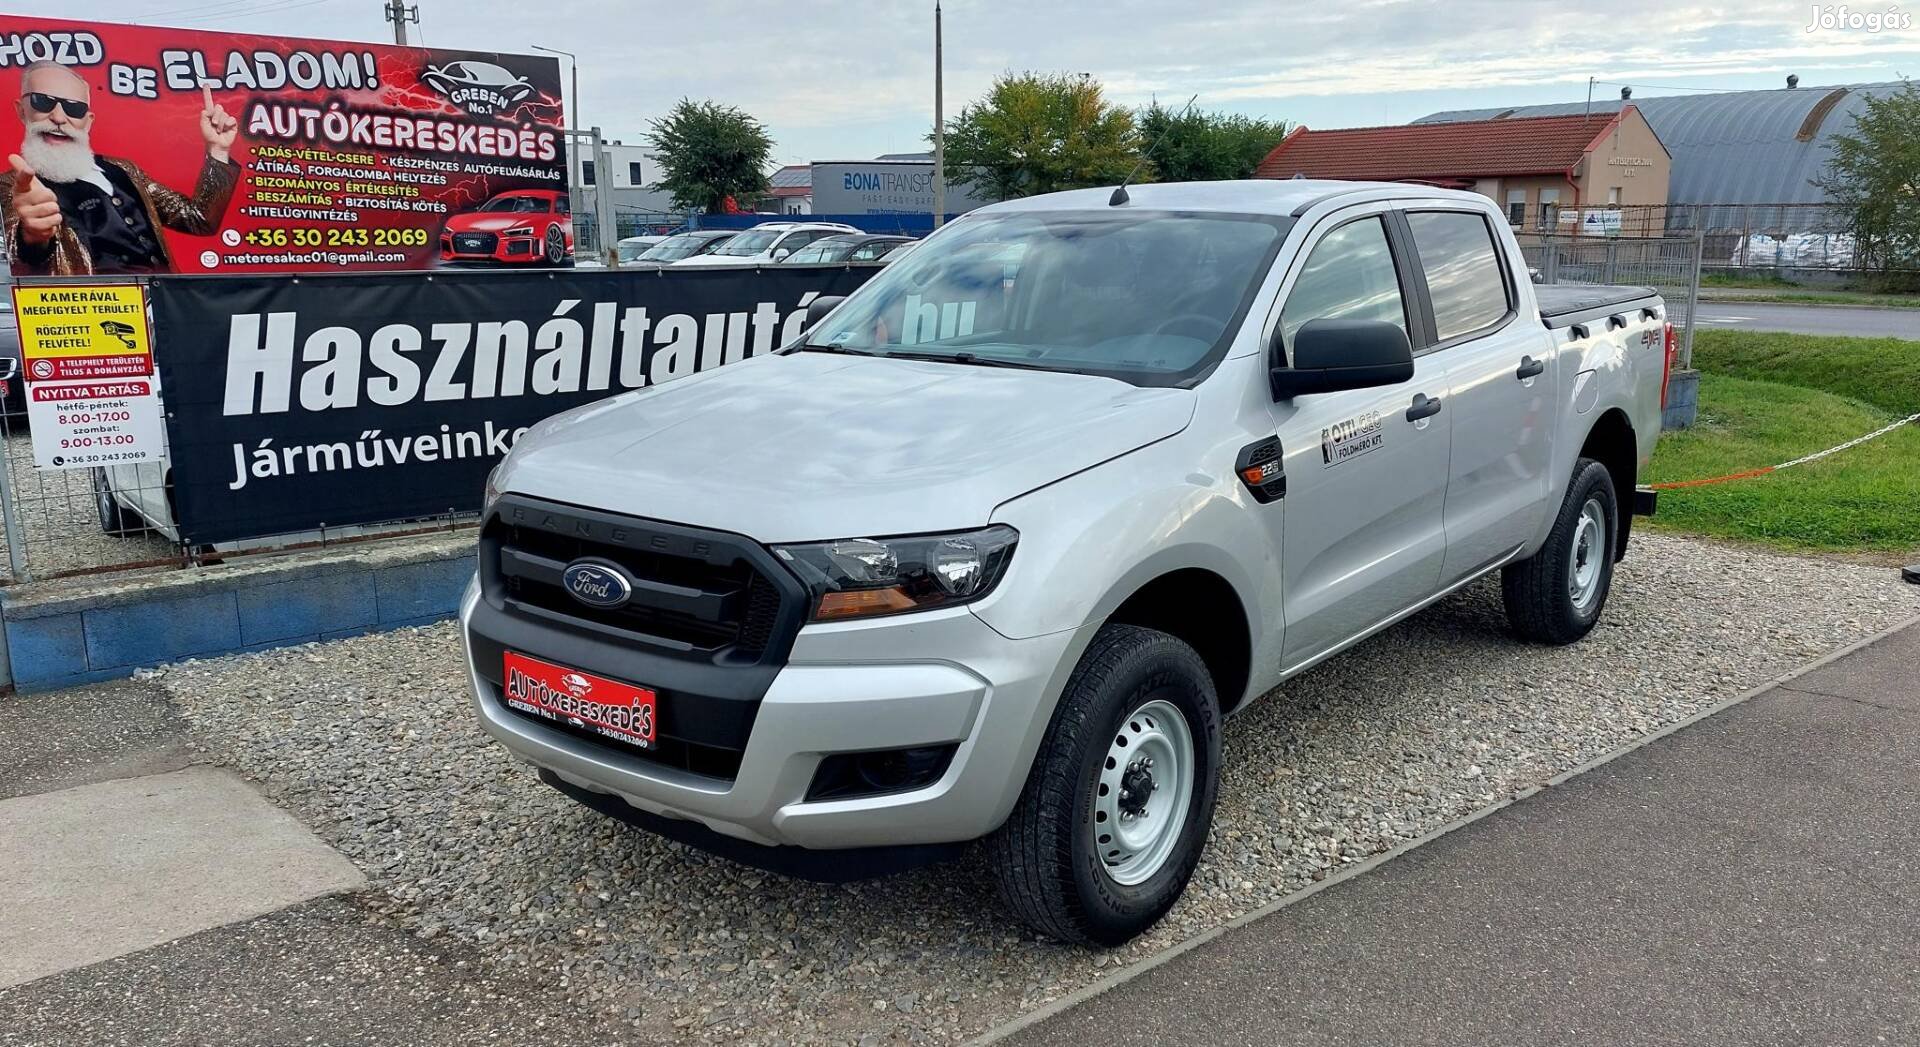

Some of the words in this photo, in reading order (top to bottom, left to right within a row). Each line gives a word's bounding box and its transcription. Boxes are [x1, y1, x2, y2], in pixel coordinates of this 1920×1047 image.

[0, 33, 103, 66] HOZD
[111, 64, 157, 98] BE
[162, 51, 378, 89] ELADOM!
[451, 88, 509, 109] GREBEN
[468, 102, 493, 115] No.1
[250, 103, 556, 161] AUTÓKERESKEDÉS
[258, 146, 374, 165] ADÁS-VÉTEL-CSERE
[256, 159, 304, 175] ÁTÍRÁS,
[308, 165, 391, 181] FORGALOMBA
[393, 172, 447, 185] HELYEZÉS
[389, 155, 460, 172] KÉSZPÉNZES
[464, 163, 561, 181] AUTÓFELVÁSÁRLÁS
[255, 176, 340, 191] BIZOMÁNYOS
[346, 181, 419, 197] ÉRTÉKESÍTÉS
[256, 191, 333, 206] BESZÁMÍTÁS
[345, 197, 410, 211] BIZTOSÍTÁS
[412, 202, 447, 213] KÖTÉS
[249, 206, 358, 222] HITELÜGYINTÉZÉS
[245, 229, 287, 247] +36
[293, 229, 322, 247] 30
[328, 229, 369, 246] 243
[374, 229, 428, 246] 2069
[41, 292, 120, 302] KAMERÁVAL
[22, 305, 87, 315] MEGFIGYELT
[93, 304, 140, 314] TERÜLET!
[36, 325, 90, 336] RÖGZÍTETT
[38, 338, 91, 349] FELVÉTEL!
[66, 359, 104, 367] TELEPHELY
[39, 388, 90, 400] NYITVA
[92, 382, 144, 396] TARTÁS:
[57, 400, 128, 411] hétfő-péntek:
[59, 411, 130, 425] 8.00-17.00
[73, 425, 120, 434] szombat:
[61, 434, 134, 448] 9.00-13.00
[66, 456, 83, 464] +36
[86, 455, 99, 463] 30
[122, 451, 146, 460] 2069
[513, 507, 711, 558] RANGER
[573, 570, 610, 598] Ford
[508, 666, 653, 738] AUTÓKERESKEDÉS
[508, 699, 539, 715] GREBEN
[541, 706, 556, 720] No.1
